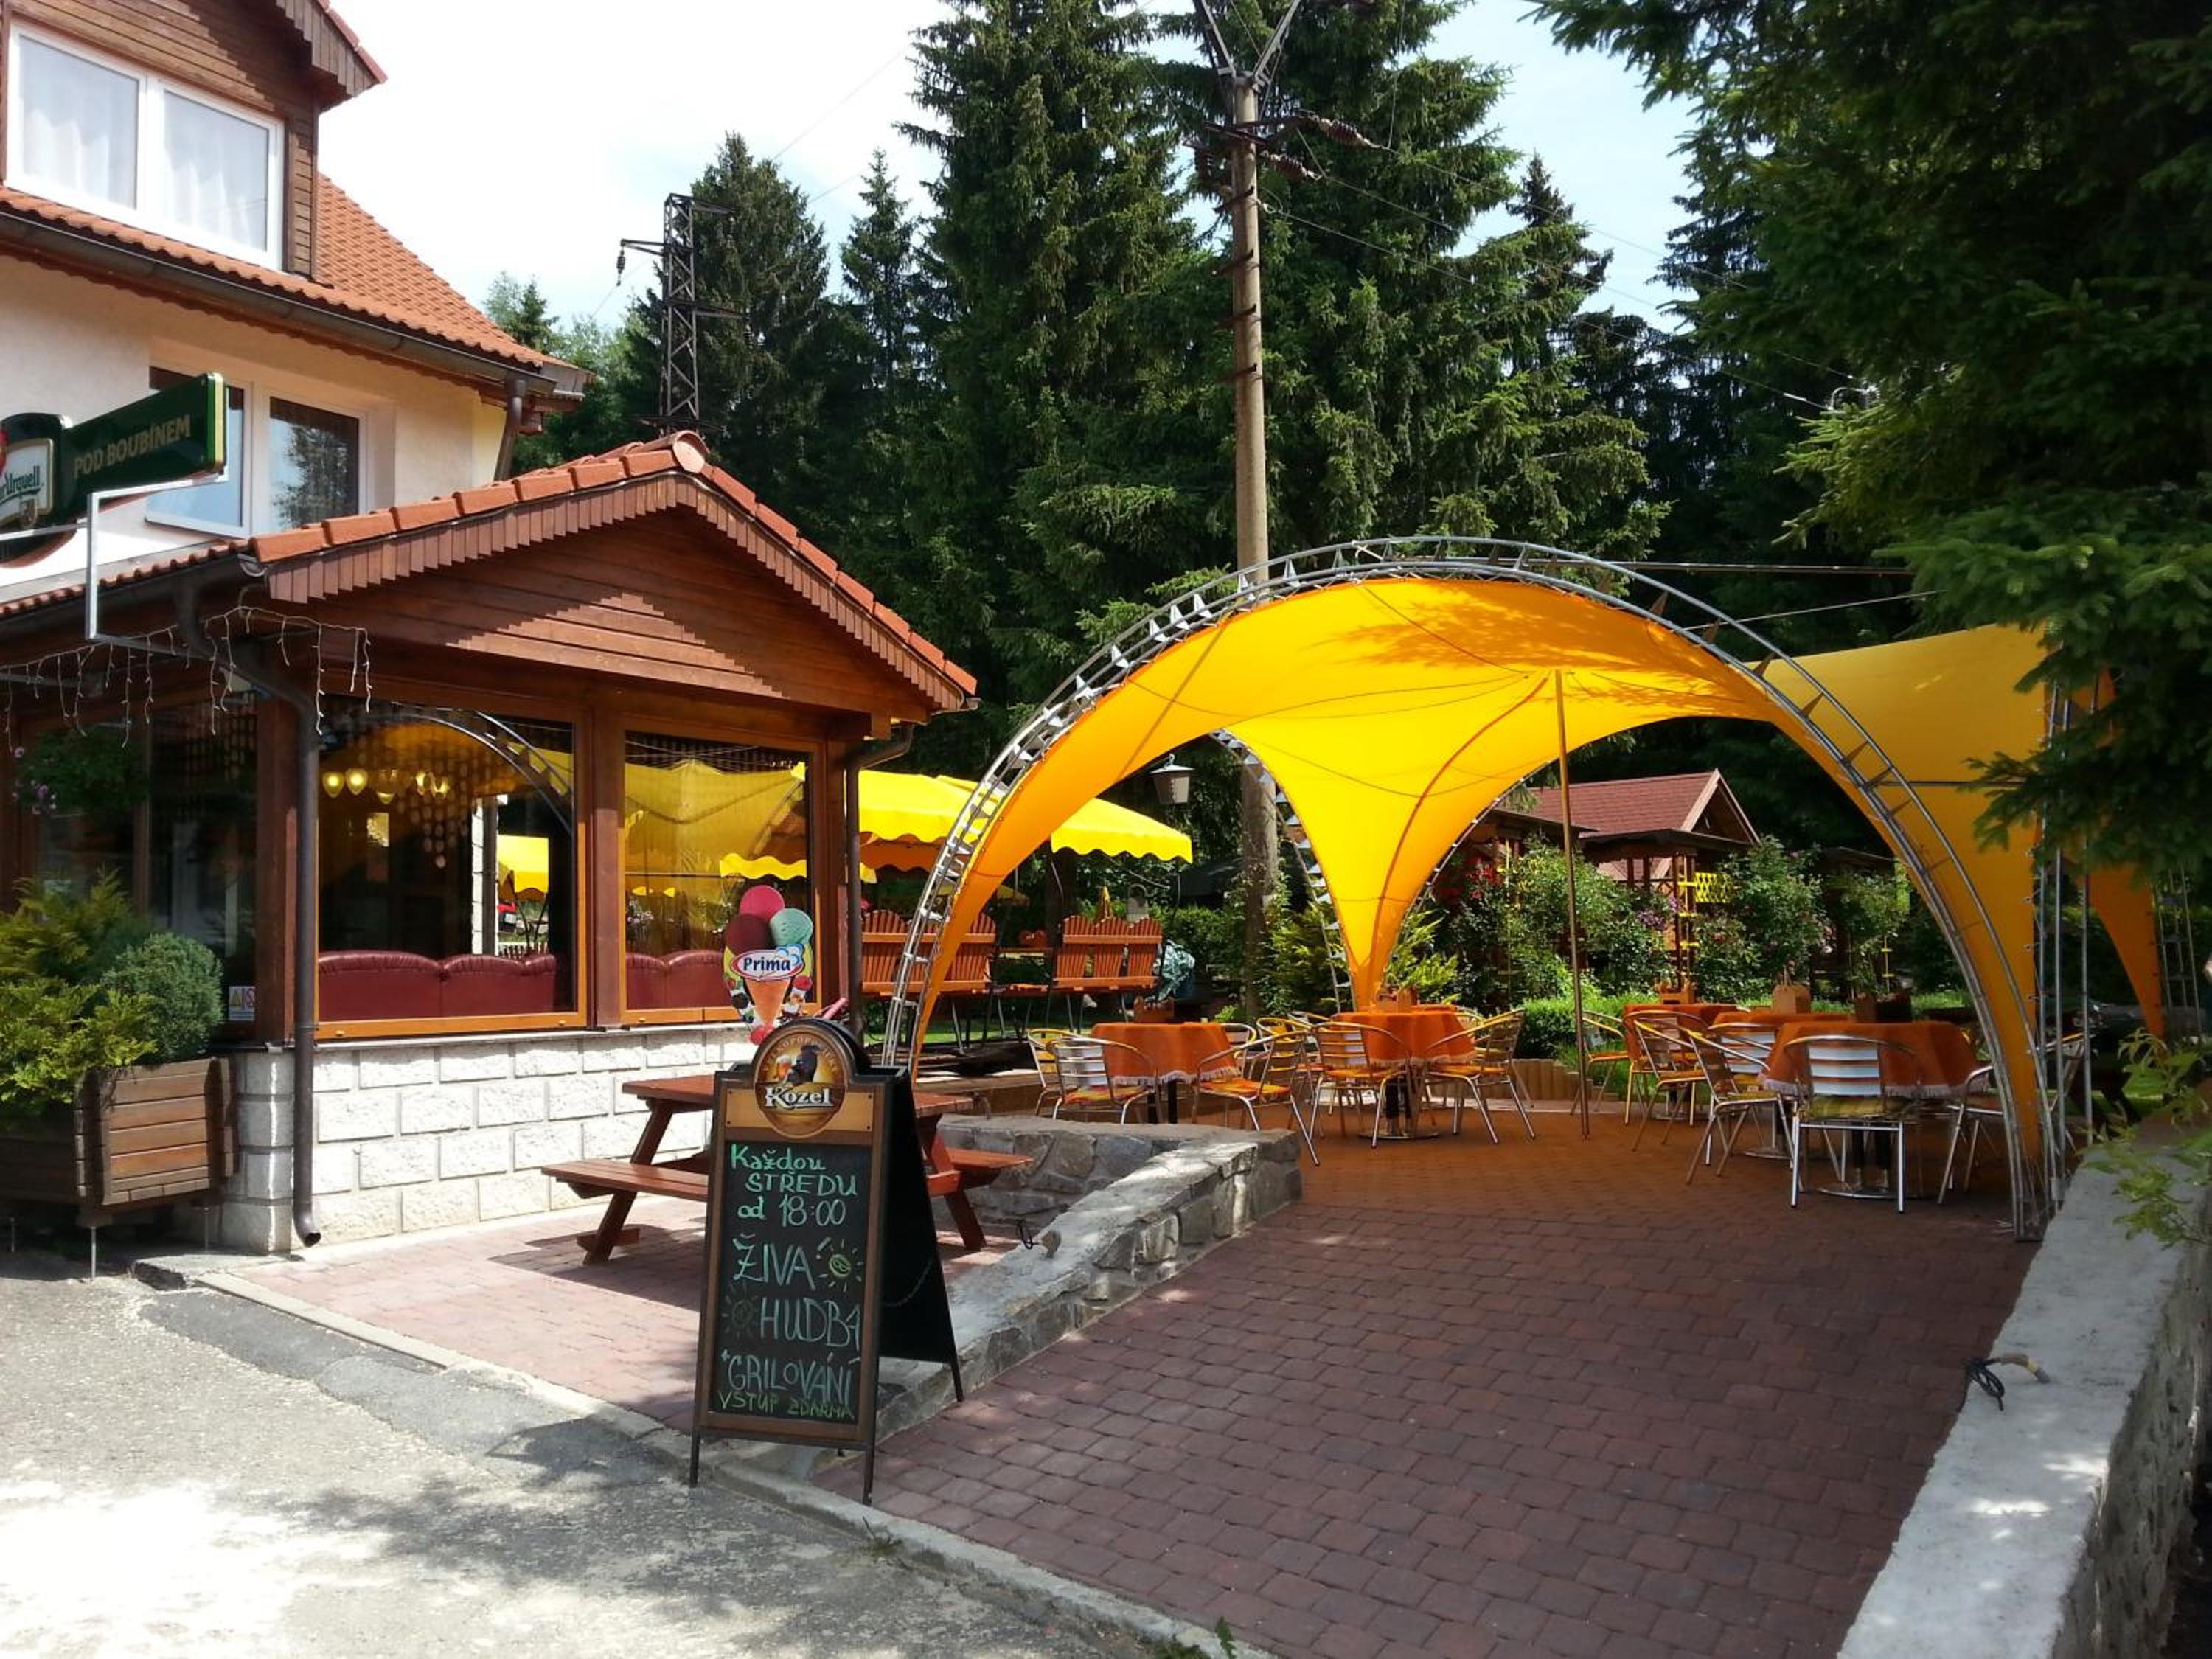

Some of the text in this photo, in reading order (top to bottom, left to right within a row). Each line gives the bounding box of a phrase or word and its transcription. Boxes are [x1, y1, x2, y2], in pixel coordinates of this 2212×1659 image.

[74, 448, 103, 479] POD
[743, 956, 791, 972] Prima
[765, 1086, 834, 1110] Kozel
[731, 1144, 827, 1171] Každou
[745, 1169, 858, 1196] STŘEDU
[737, 1194, 846, 1228] od 18:00
[760, 1297, 860, 1352] HUDBA
